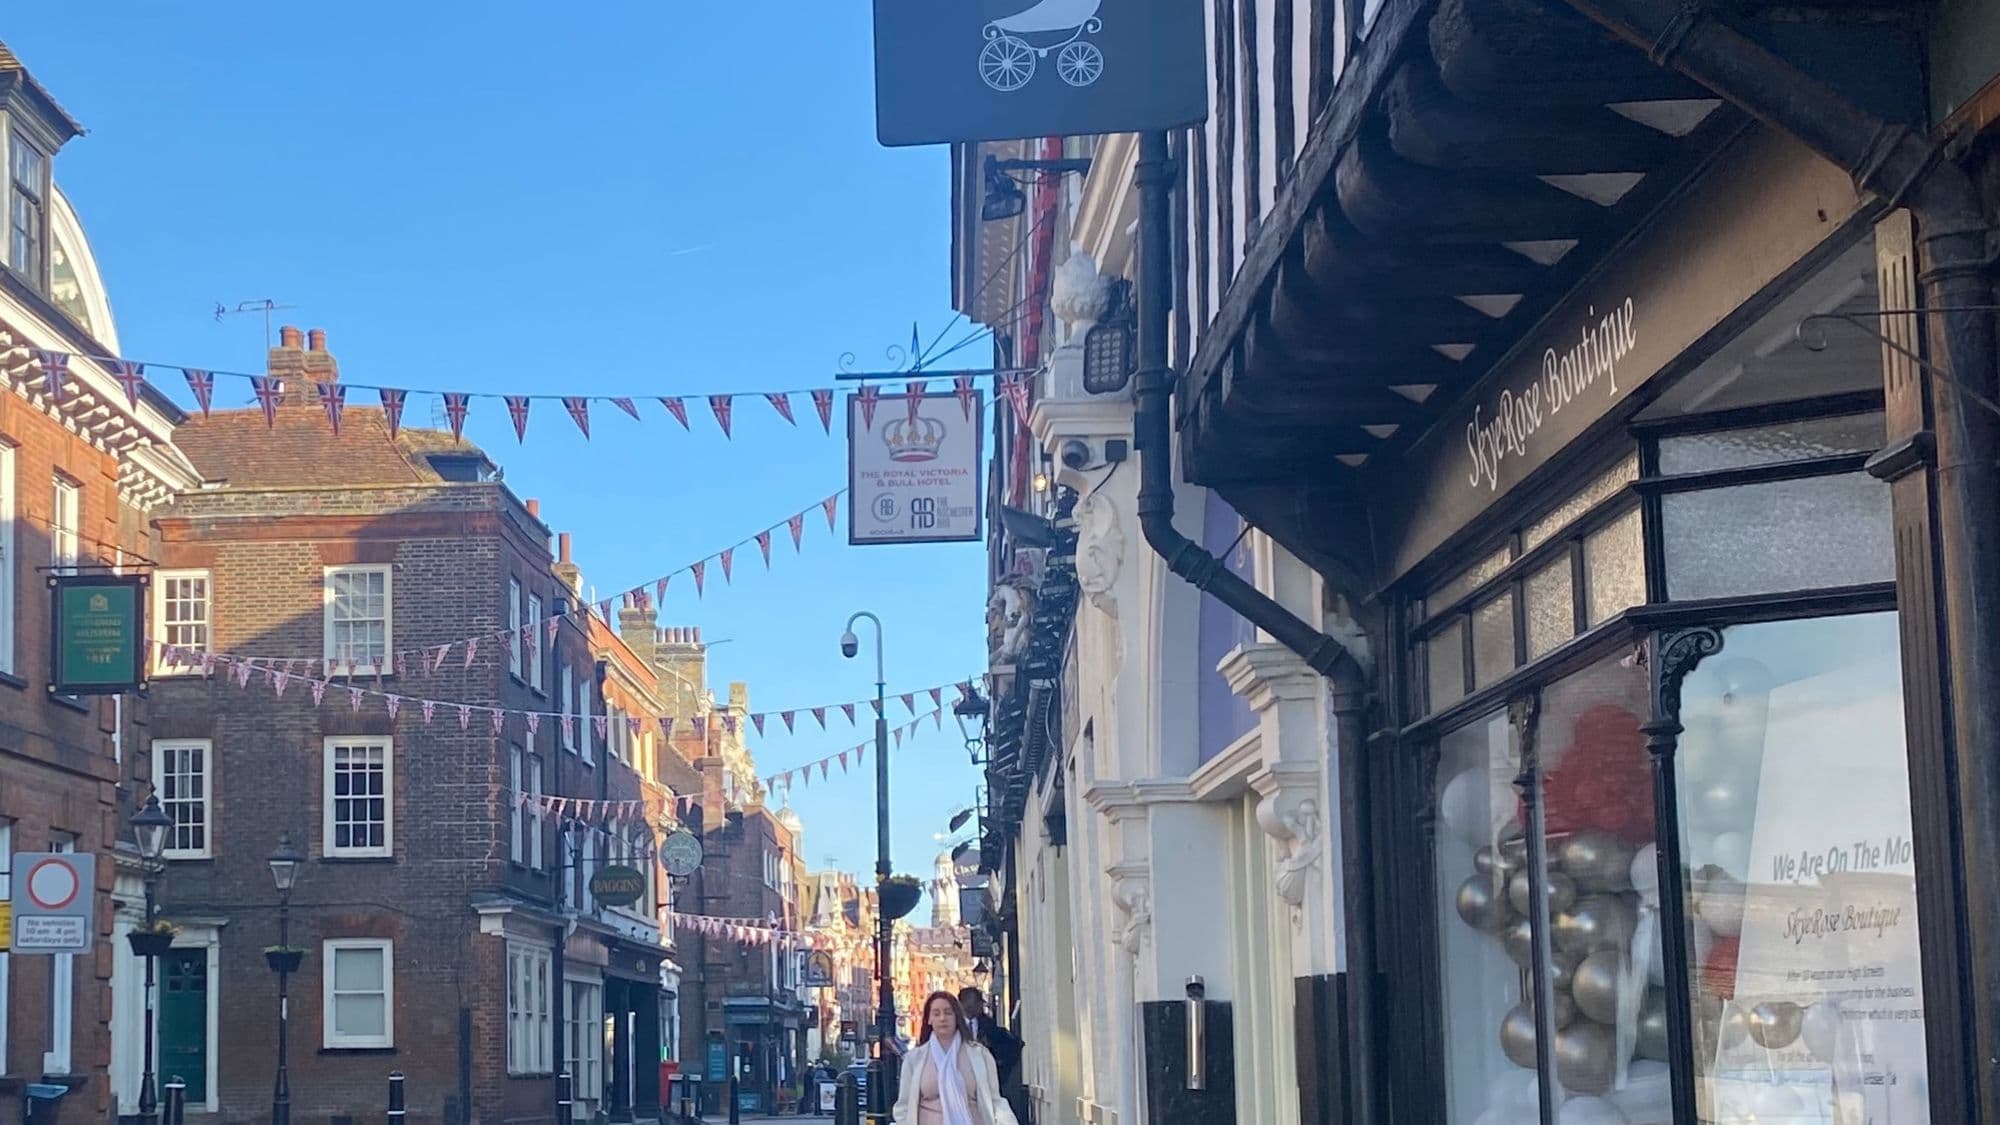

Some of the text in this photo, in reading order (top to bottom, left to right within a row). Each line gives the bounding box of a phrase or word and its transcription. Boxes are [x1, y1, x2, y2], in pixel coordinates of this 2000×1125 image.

[1466, 297, 1637, 491] SkyeRose Boutique
[861, 468, 968, 479] THE ROYAL VICTORIA
[876, 478, 952, 488] & BULL HOTEL
[1773, 836, 1911, 881] We Are On The Mo
[594, 878, 640, 893] BAGGINS
[1783, 901, 1901, 944] SkyeRose Boutique
